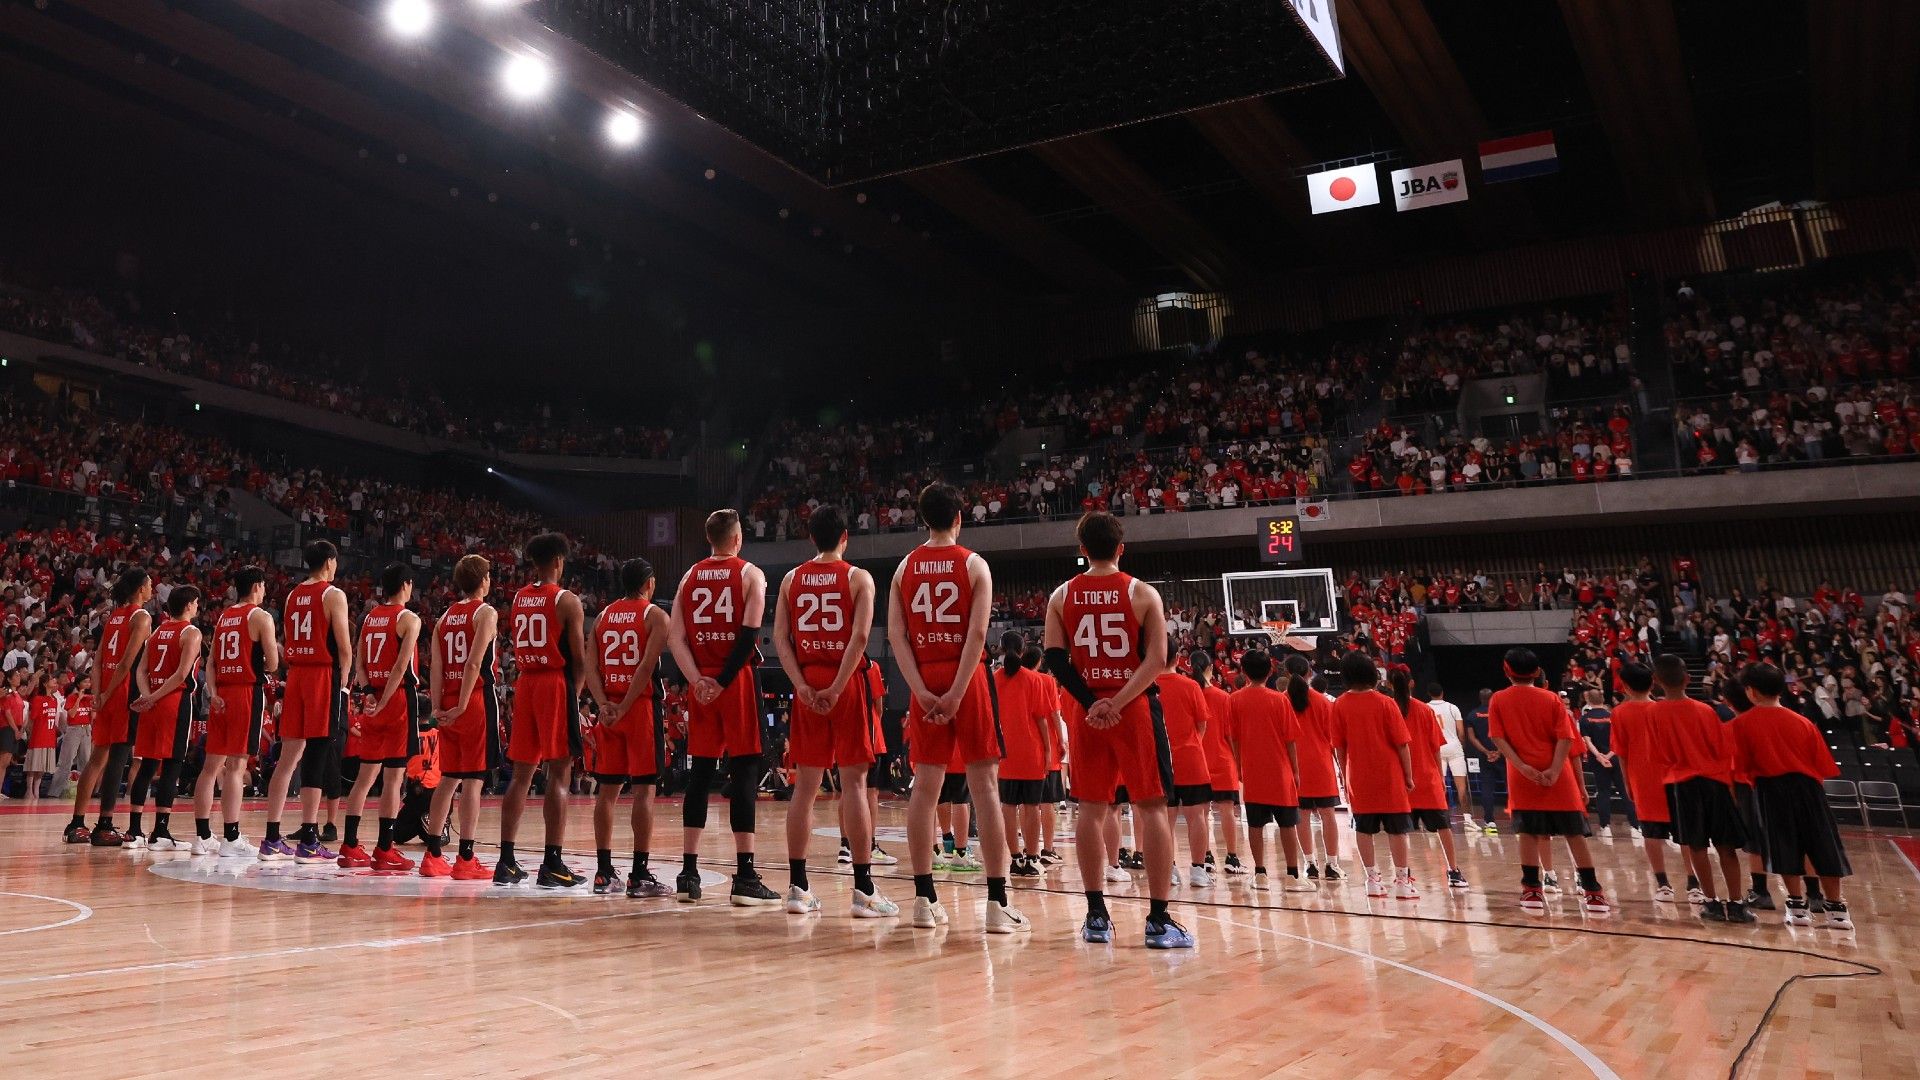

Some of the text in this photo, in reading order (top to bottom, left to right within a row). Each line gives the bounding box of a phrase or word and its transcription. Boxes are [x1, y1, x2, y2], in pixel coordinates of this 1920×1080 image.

[1401, 176, 1442, 196] JBA
[1269, 520, 1293, 535] 5:32
[1269, 535, 1292, 554] 24
[697, 568, 731, 581] HAWKINSON
[914, 560, 955, 575] L.WATANABE
[801, 573, 837, 586] KAWASHIMA
[691, 586, 734, 624] 24
[911, 581, 961, 623] 42
[1074, 590, 1119, 605] L.TOEWS
[608, 611, 637, 623] HARPER
[796, 592, 844, 632] 25
[291, 610, 312, 640] 14
[515, 613, 547, 648] 20
[706, 632, 735, 641] 日本生命
[1073, 613, 1130, 658] 45
[107, 630, 119, 656] 4
[219, 630, 240, 660] 13
[365, 632, 387, 663] 17
[444, 630, 468, 664] 19
[602, 629, 640, 666] 23
[928, 632, 963, 643] 日本生命
[154, 644, 168, 672] 7
[1092, 667, 1134, 679] 日本生命
[47, 719, 55, 730] 17
